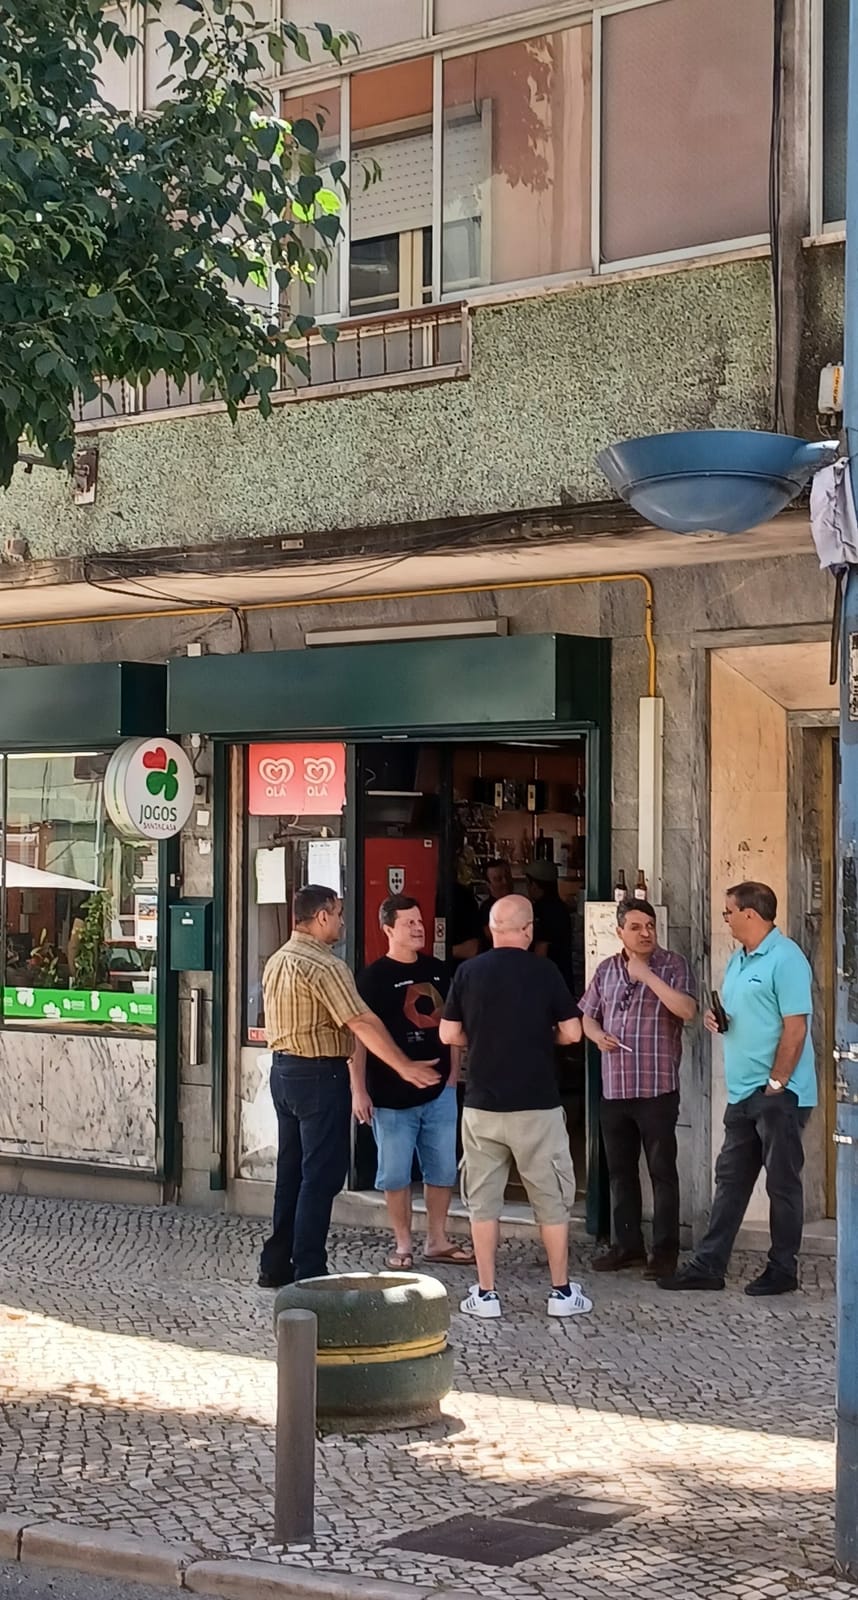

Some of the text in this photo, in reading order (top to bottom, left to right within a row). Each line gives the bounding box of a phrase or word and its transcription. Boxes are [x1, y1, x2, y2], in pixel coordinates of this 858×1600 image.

[265, 783, 328, 797] OLÁ OLÁ
[139, 804, 177, 825] JOGOS
